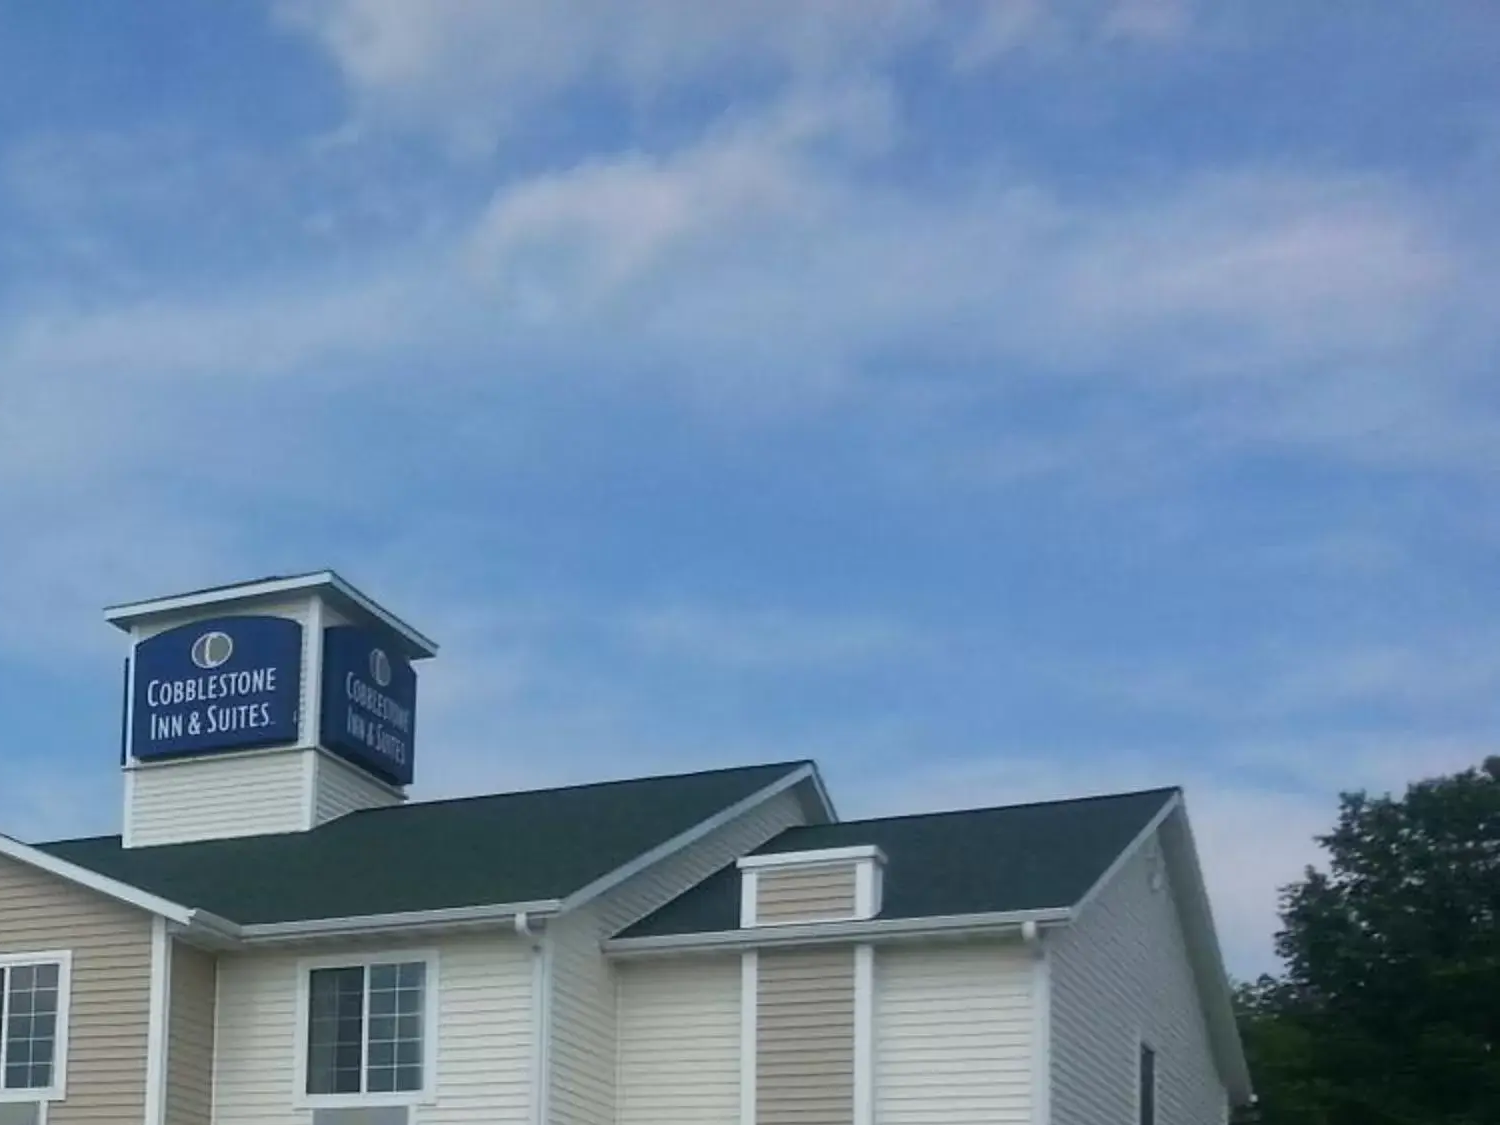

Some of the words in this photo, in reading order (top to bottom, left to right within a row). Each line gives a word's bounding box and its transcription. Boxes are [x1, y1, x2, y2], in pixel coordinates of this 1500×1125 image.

[147, 668, 276, 706] COBBLESTONE
[151, 713, 183, 740] INN
[188, 711, 201, 735] &
[207, 702, 270, 733] SUITES
